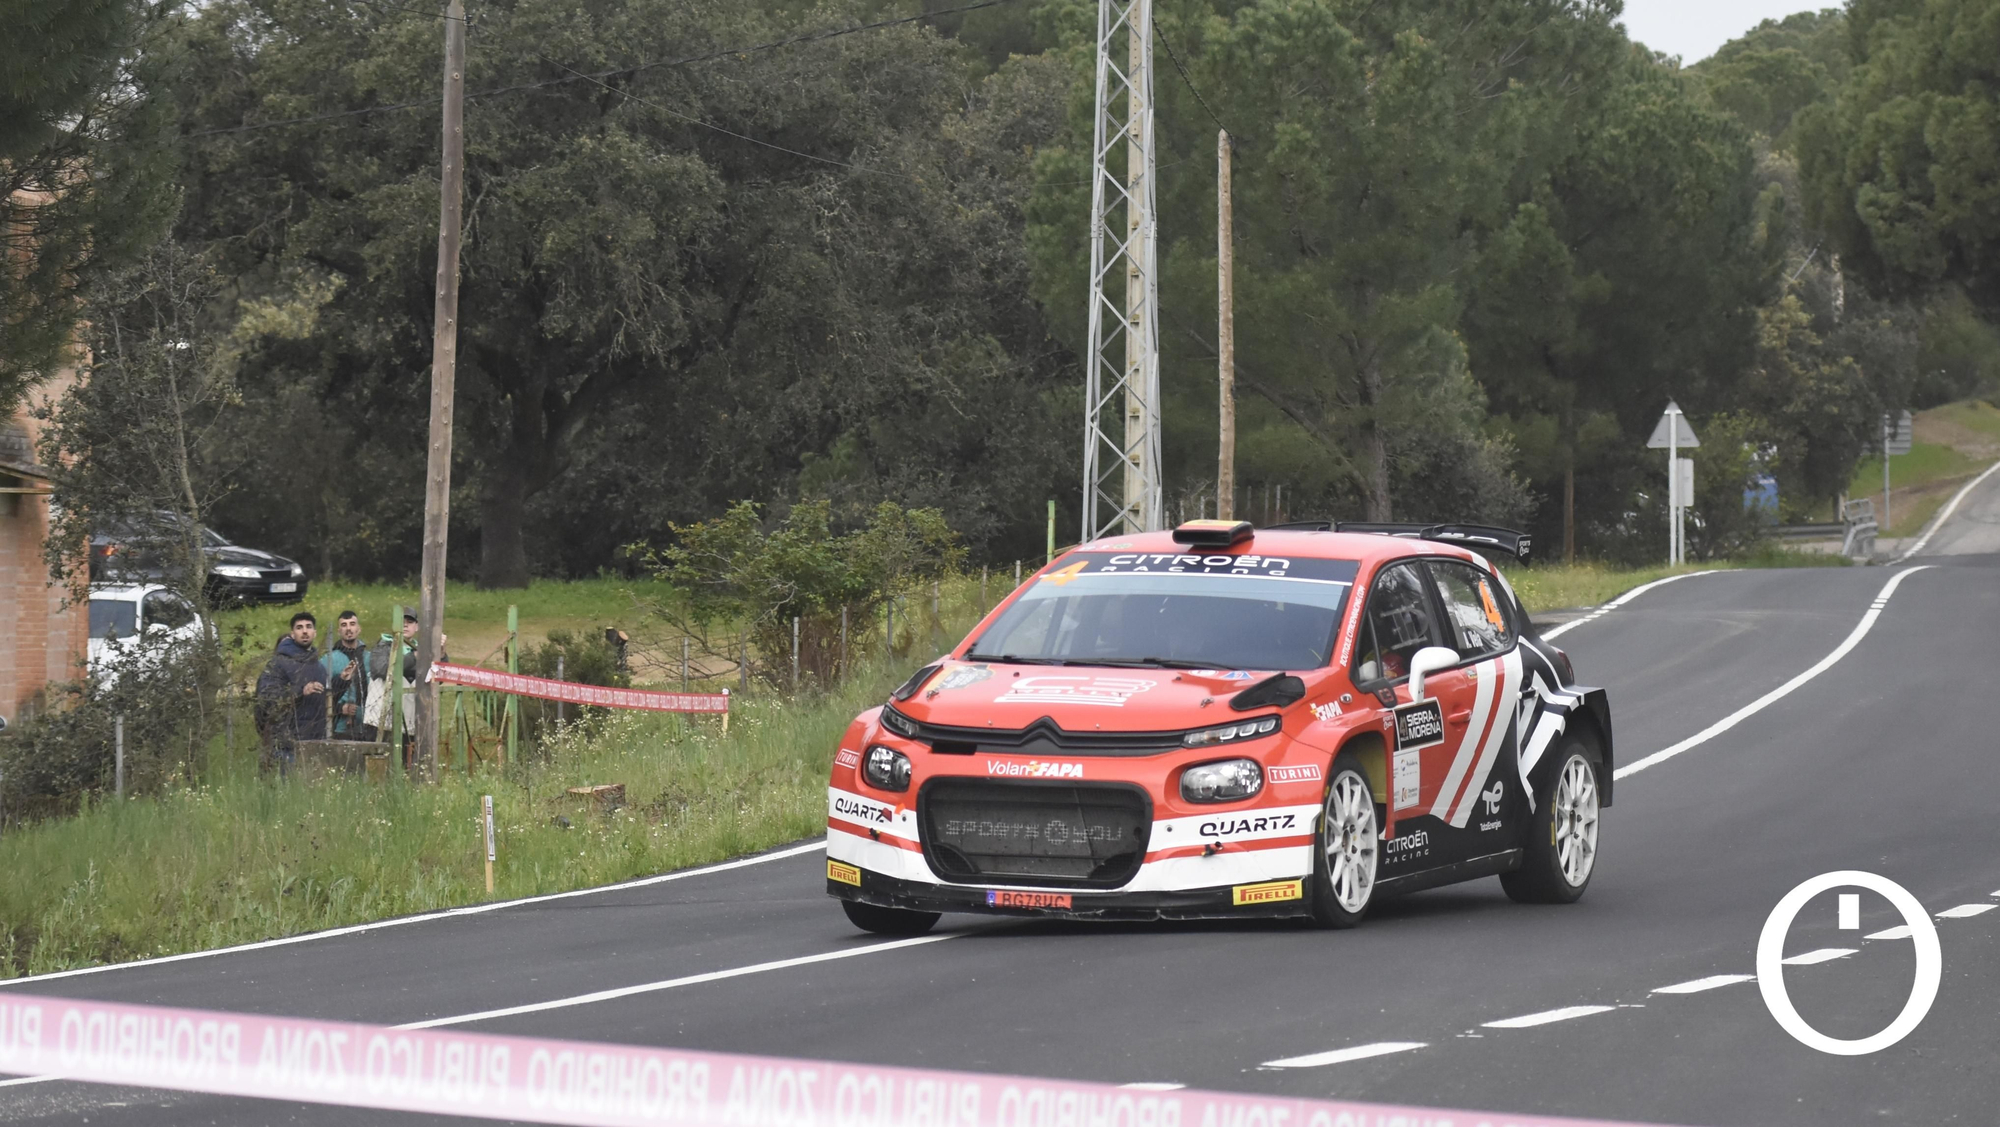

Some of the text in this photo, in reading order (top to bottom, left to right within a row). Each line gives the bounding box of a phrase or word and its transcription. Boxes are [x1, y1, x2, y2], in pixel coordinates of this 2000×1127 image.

[1040, 560, 1089, 586] 4
[1478, 581, 1506, 633] 4
[1406, 710, 1434, 727] SIERRA
[1408, 721, 1441, 740] MORENA
[1271, 767, 1317, 780] TURINI
[835, 797, 885, 824] QUARTZ
[1199, 814, 1296, 837] QUARTZ
[830, 863, 858, 883] PIRELLI
[1240, 883, 1296, 902] PIRELLI
